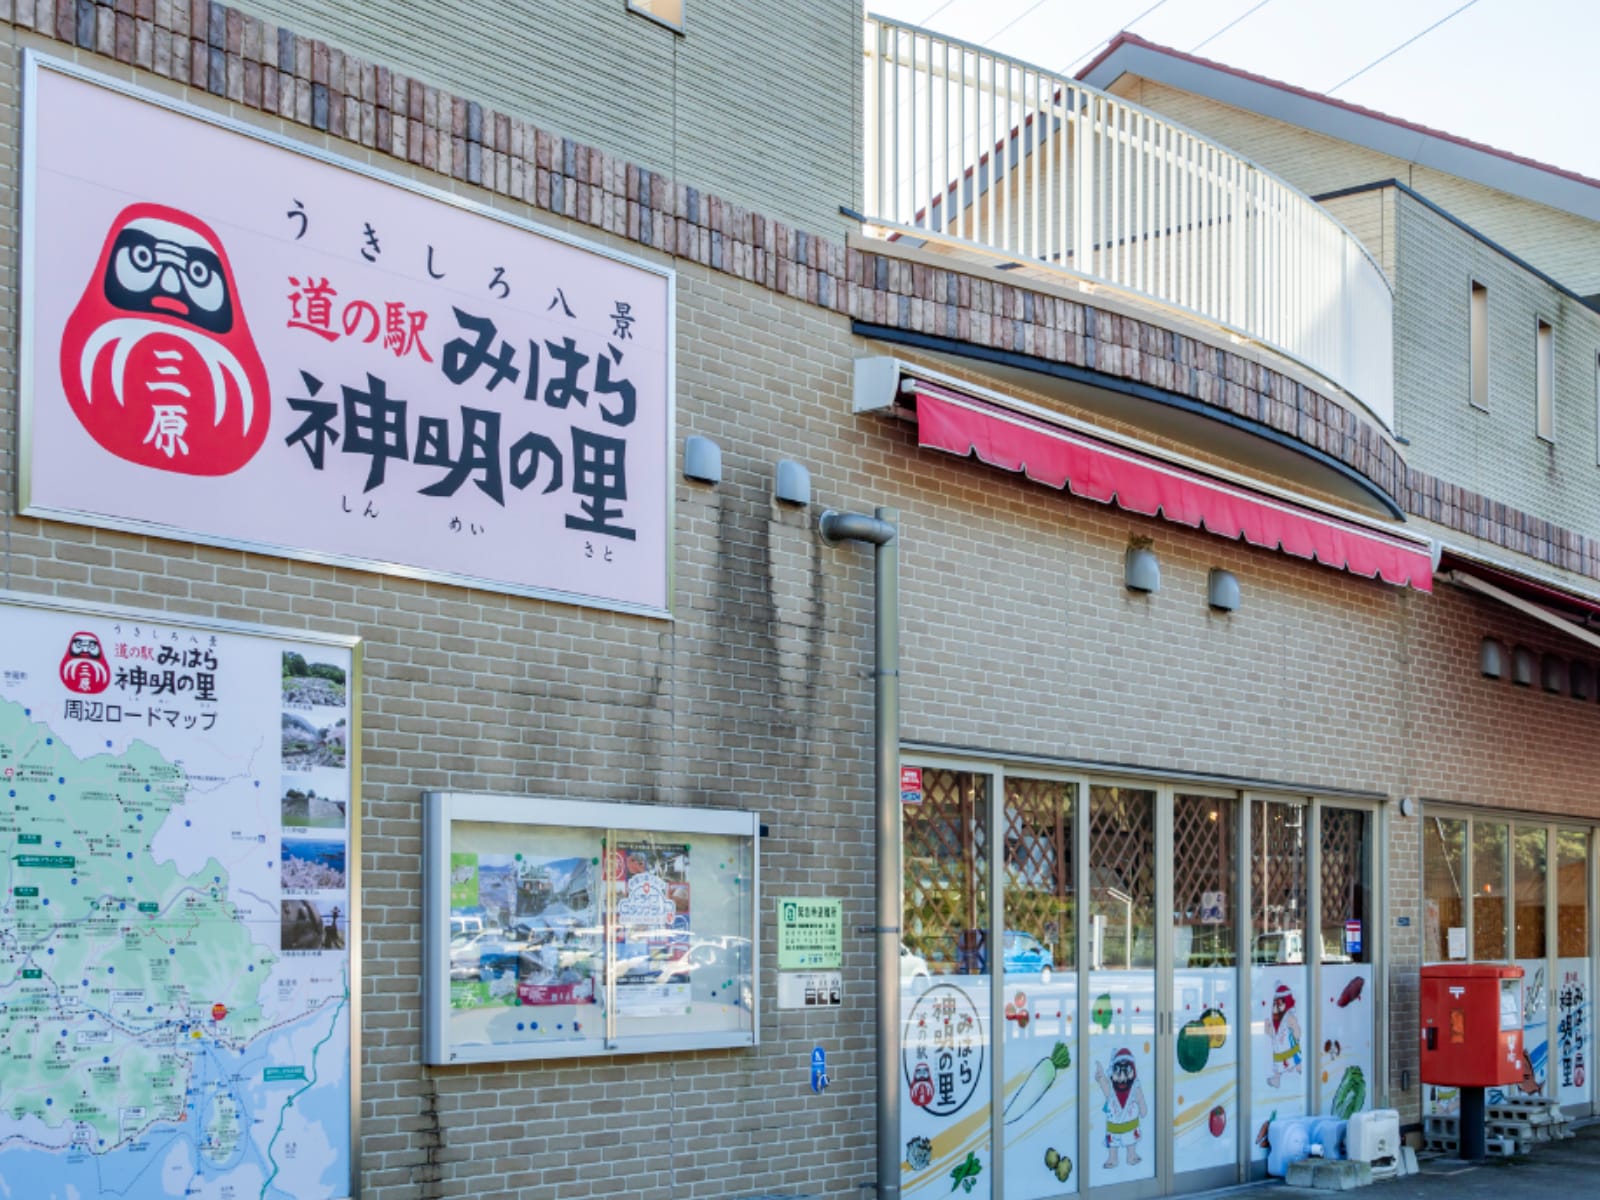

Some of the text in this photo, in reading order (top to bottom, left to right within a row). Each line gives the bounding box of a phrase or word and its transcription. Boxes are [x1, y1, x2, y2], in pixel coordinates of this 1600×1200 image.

[287, 198, 635, 341] うきしろ八景
[287, 276, 637, 427] 道の駅 みはら
[143, 350, 191, 458] 三原
[284, 370, 637, 541] 神明の里
[342, 495, 379, 519] しん
[449, 516, 485, 536] めい
[583, 540, 614, 563] さと
[114, 642, 218, 671] 道の駅 みはら
[114, 665, 218, 702] 神明の里
[63, 699, 218, 731] 周辺ロードマップ
[932, 993, 956, 1106] 神明の里
[957, 1013, 974, 1085] みはら
